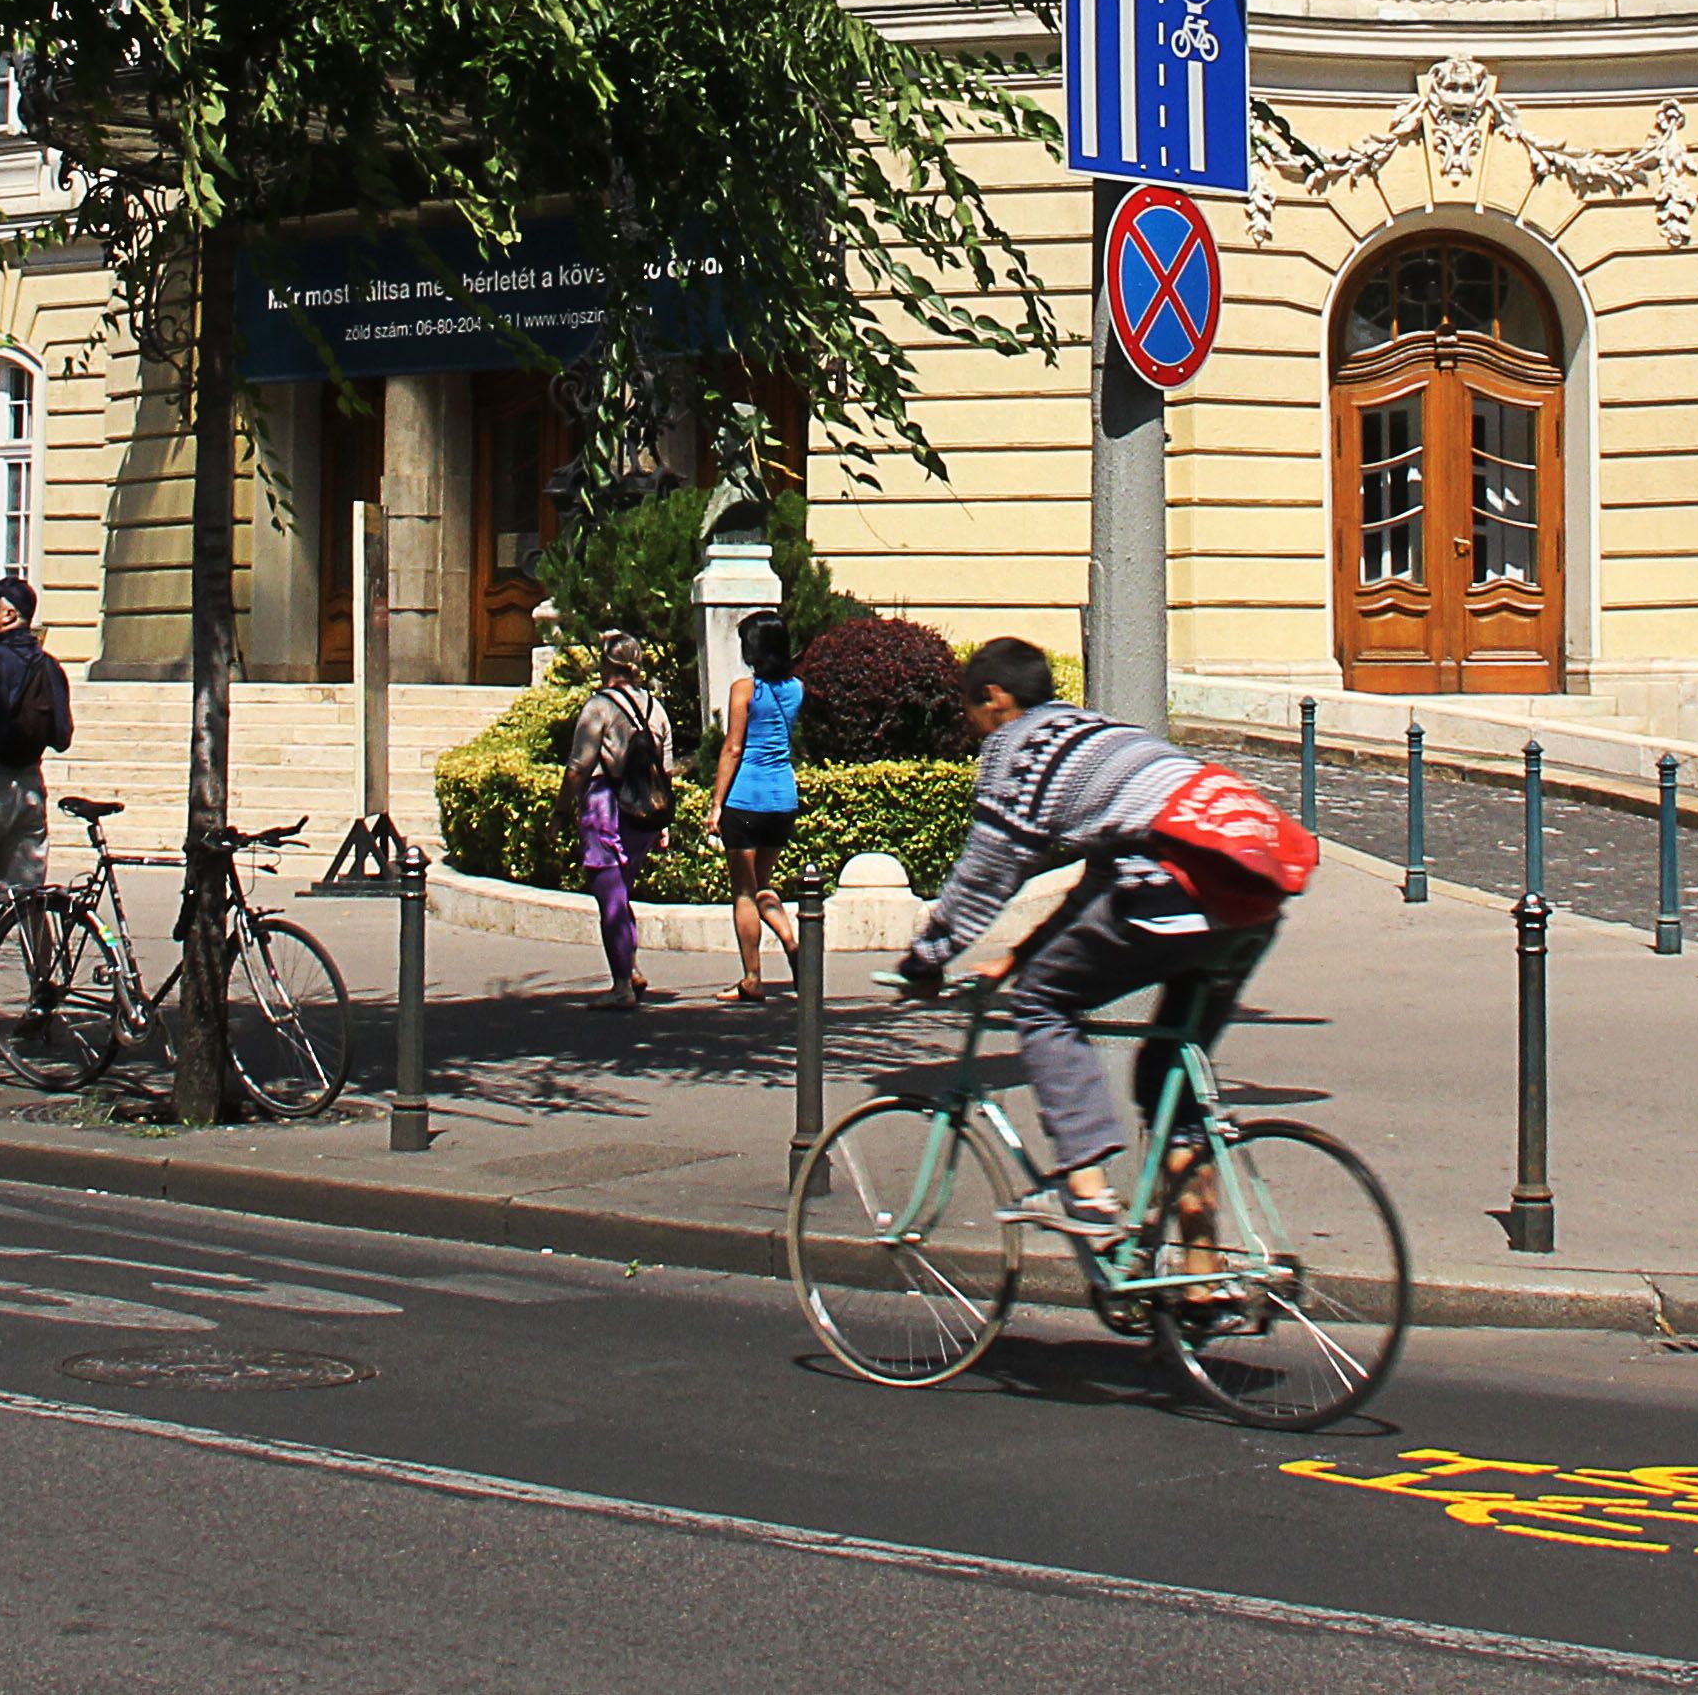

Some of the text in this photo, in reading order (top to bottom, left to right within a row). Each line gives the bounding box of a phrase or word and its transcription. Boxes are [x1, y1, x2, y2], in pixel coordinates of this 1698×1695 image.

[305, 284, 350, 306] most
[416, 279, 454, 302] me
[542, 271, 553, 288] a
[345, 323, 370, 342] zöld
[374, 320, 413, 339] szám:
